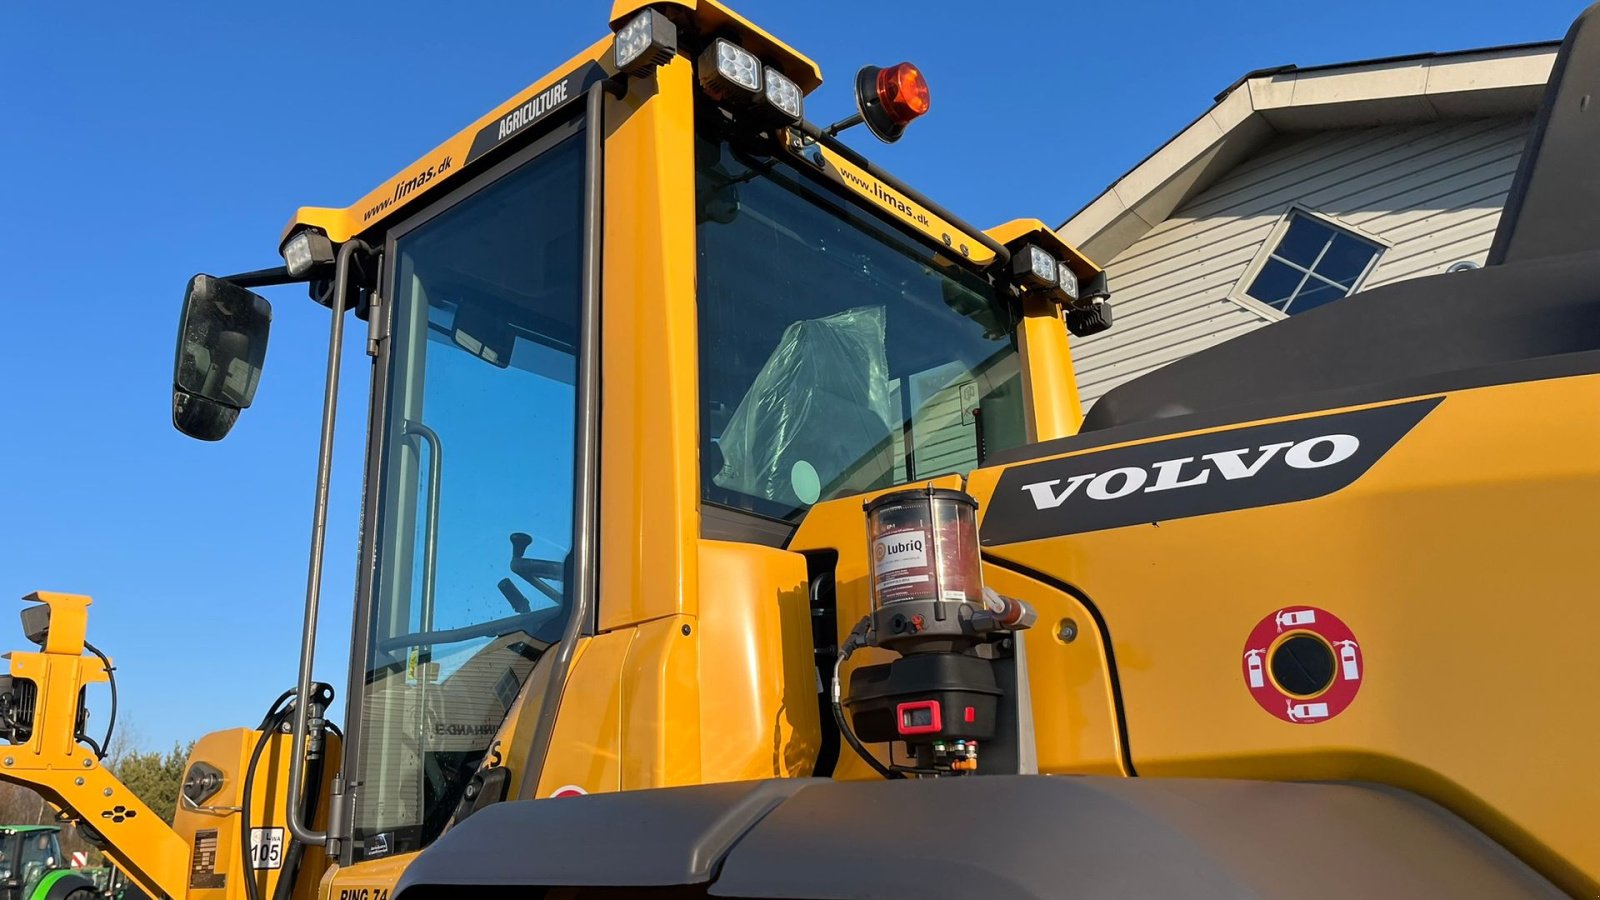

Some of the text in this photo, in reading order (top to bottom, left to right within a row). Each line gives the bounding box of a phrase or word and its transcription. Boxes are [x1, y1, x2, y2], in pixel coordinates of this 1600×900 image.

[498, 79, 568, 141] AGRICULTURE
[363, 156, 453, 222] www.limas.dk
[840, 167, 930, 228] www.limas.dk
[1021, 434, 1360, 510] VOLVO
[887, 540, 922, 555] LubriQ
[251, 844, 279, 862] 105
